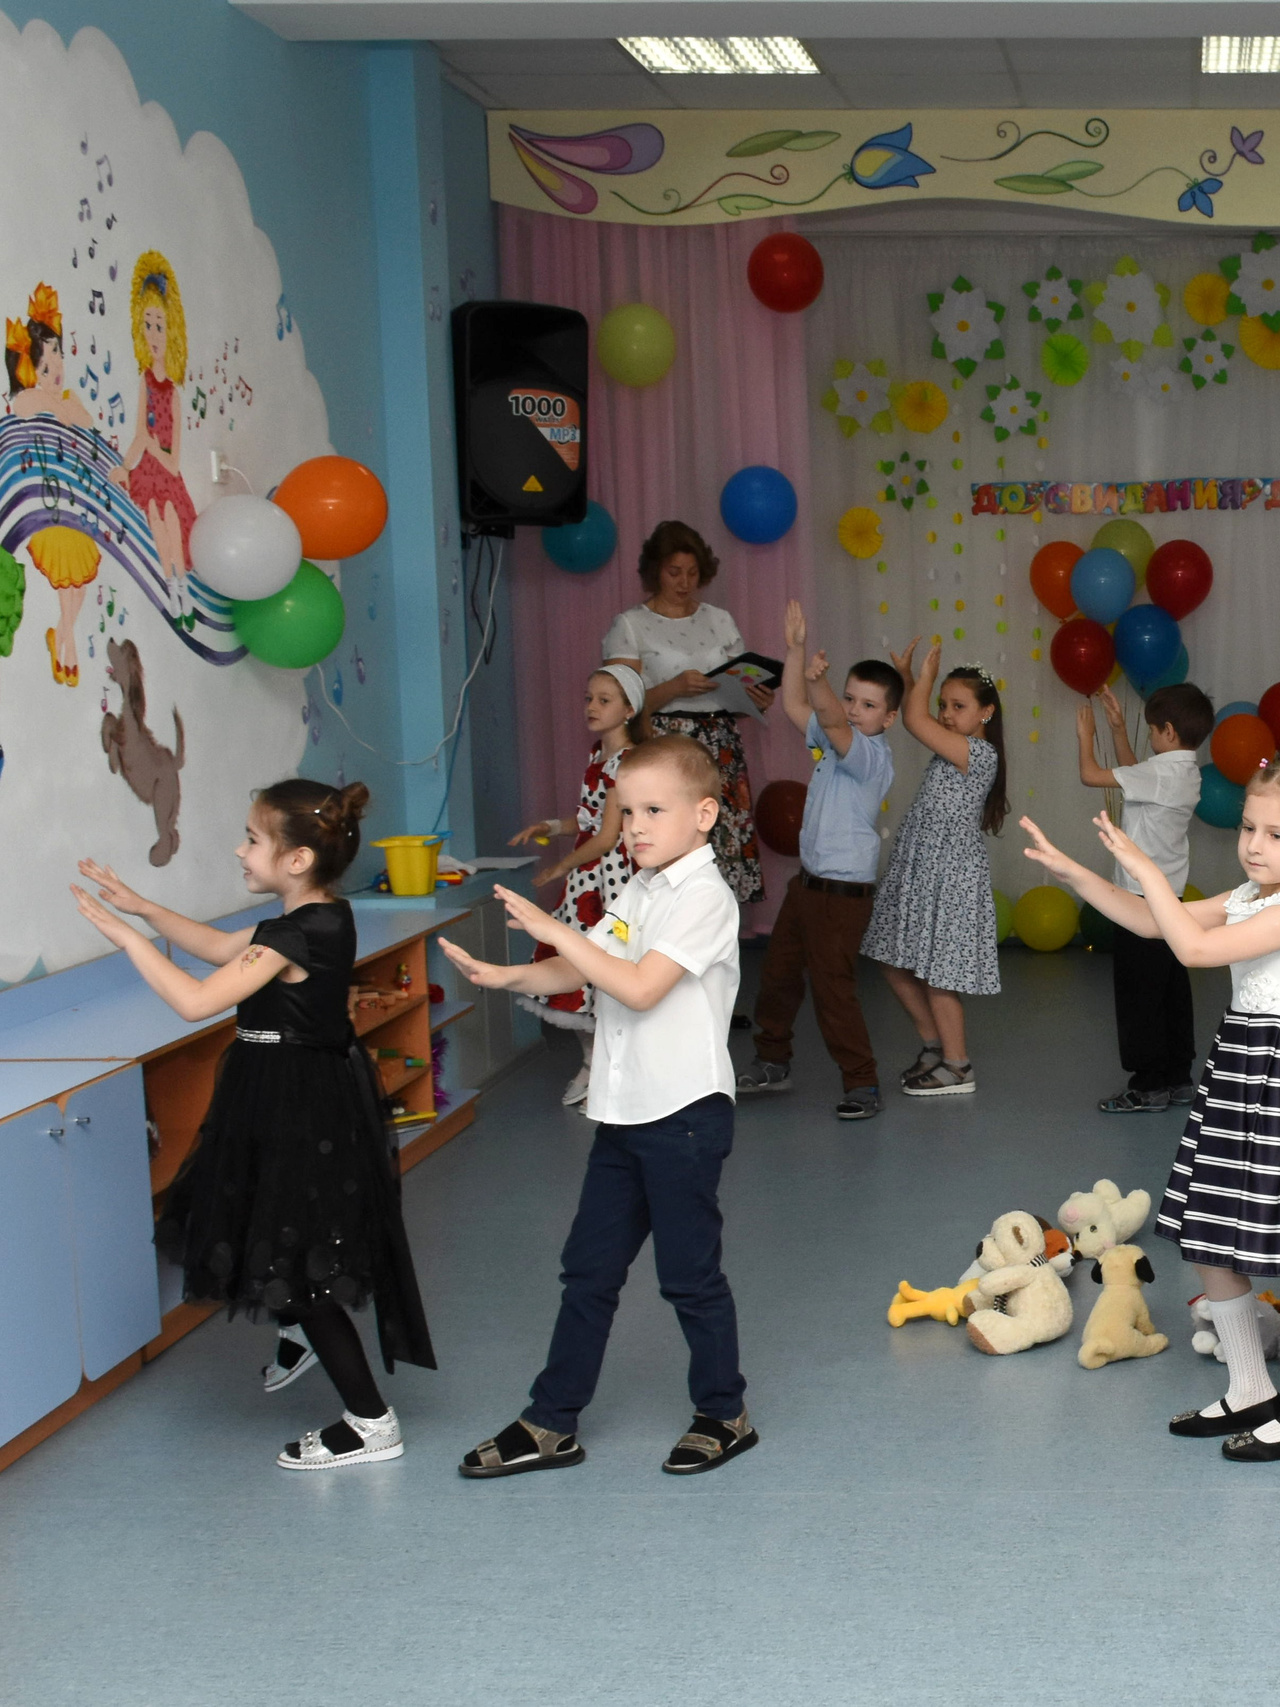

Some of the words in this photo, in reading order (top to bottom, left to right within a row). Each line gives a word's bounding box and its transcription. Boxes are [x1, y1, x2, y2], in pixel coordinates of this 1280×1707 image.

[509, 395, 566, 417] 1000
[550, 427, 577, 440] MP3
[971, 483, 1027, 515] ДО
